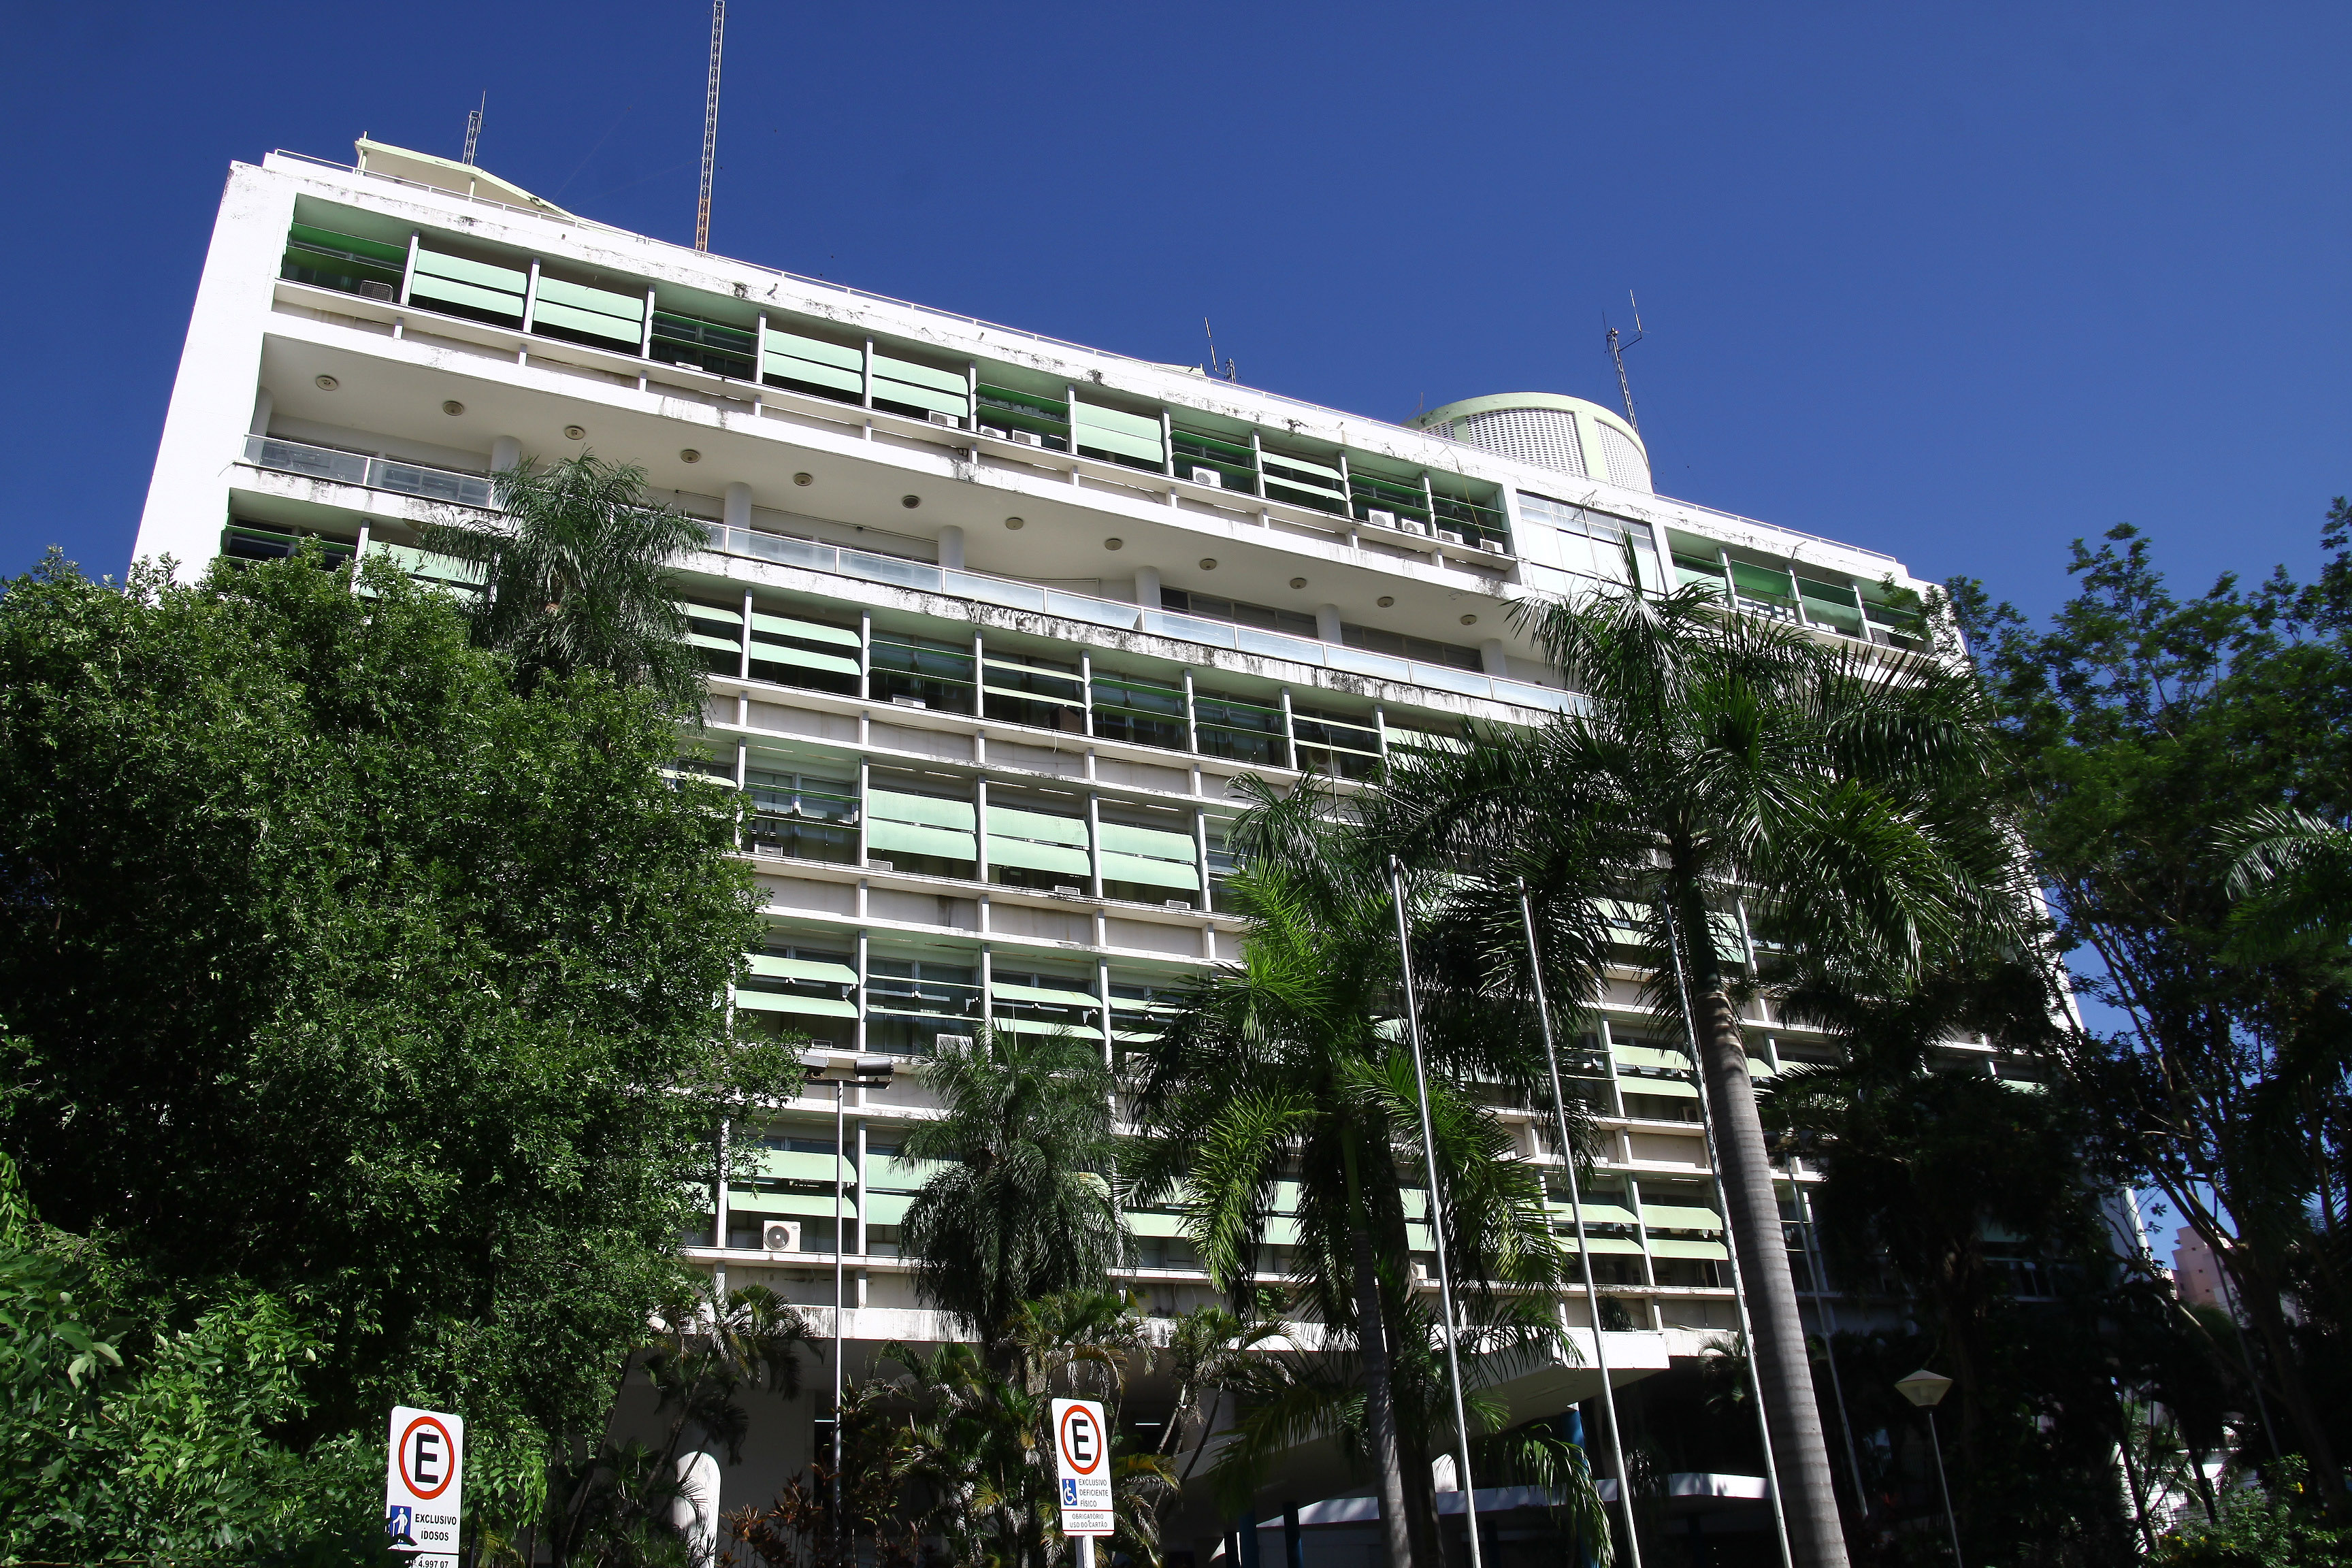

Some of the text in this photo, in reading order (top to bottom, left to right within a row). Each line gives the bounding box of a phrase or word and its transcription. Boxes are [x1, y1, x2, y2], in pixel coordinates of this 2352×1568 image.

[1072, 1419, 1092, 1461] E
[414, 1433, 440, 1484] E
[1080, 1499, 1097, 1507] FÍSICO
[415, 1514, 457, 1525] EXCLUSIVO
[421, 1531, 449, 1541] IDOSOS
